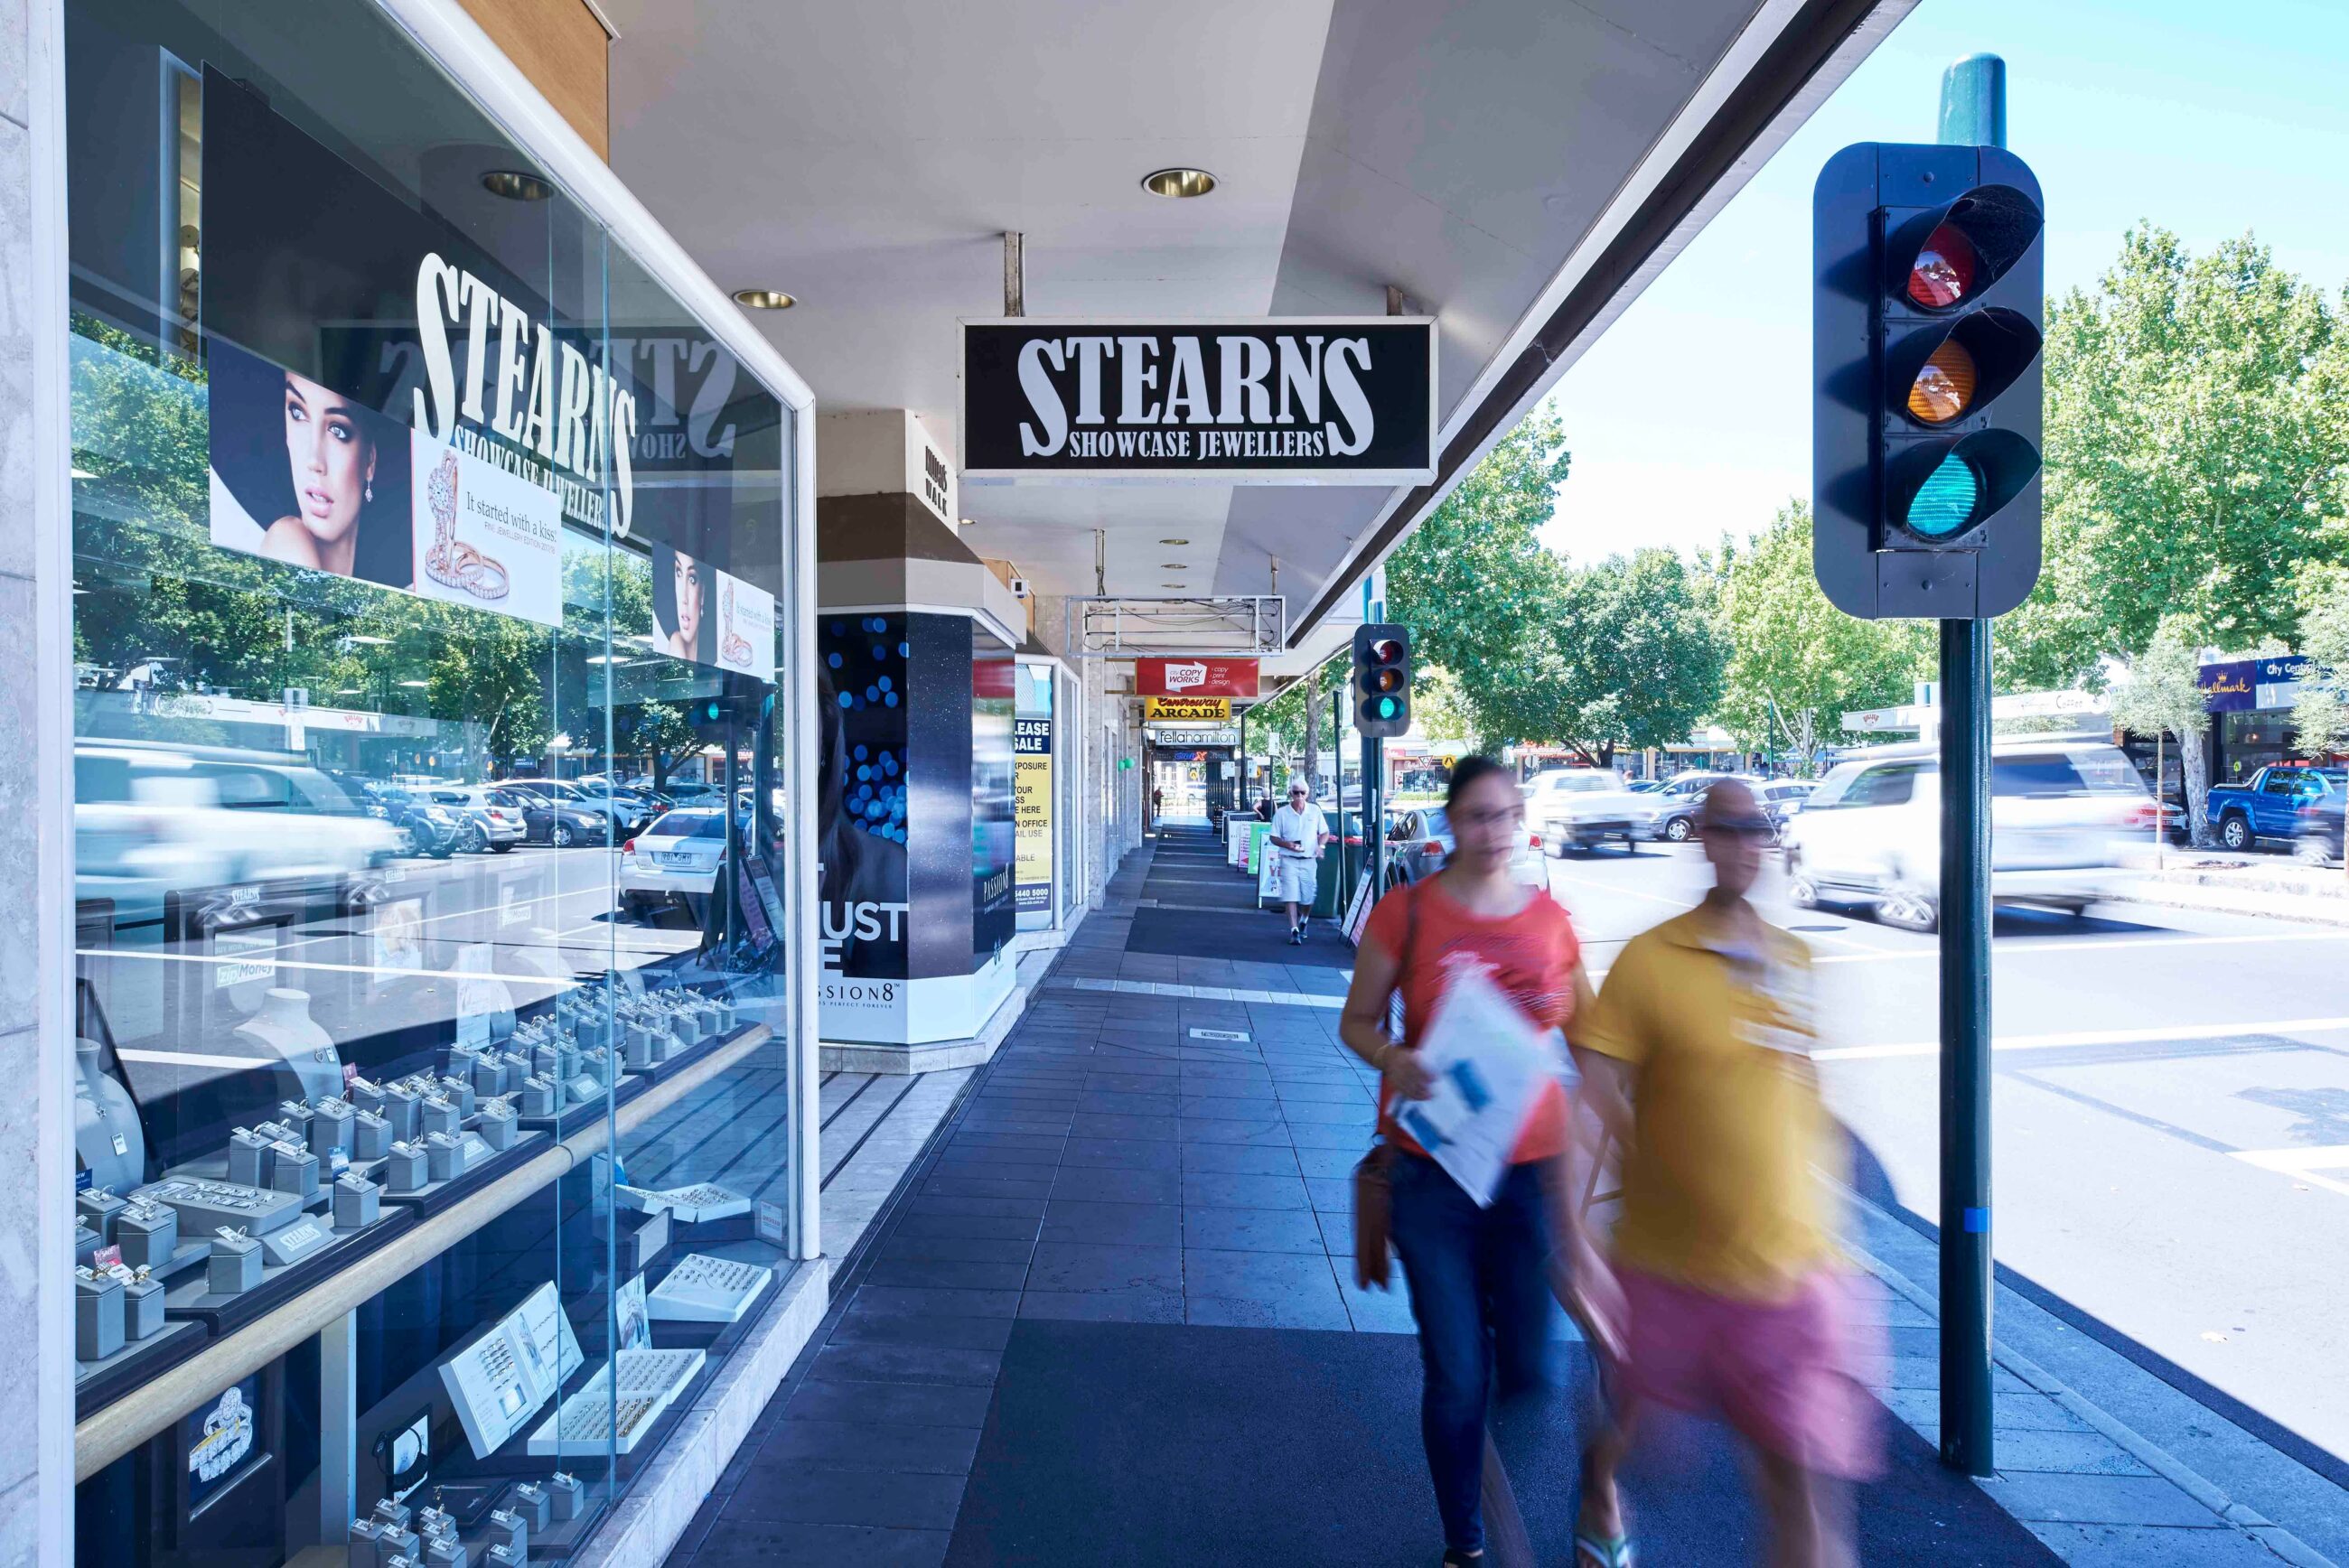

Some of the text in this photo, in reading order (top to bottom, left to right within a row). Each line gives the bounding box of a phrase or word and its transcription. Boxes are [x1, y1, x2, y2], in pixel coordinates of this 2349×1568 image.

[414, 252, 636, 539] STEARNS
[1017, 335, 1374, 457] STEARNS
[1070, 432, 1325, 461] SHOWCASE JEWELLERS
[467, 491, 475, 512] It
[477, 500, 509, 524] started
[511, 513, 530, 533] with
[533, 522, 538, 535] a
[524, 536, 541, 549] EDITION
[1180, 668, 1203, 677] COPY
[2267, 662, 2282, 677] City
[1169, 676, 1200, 684] WORKS
[2196, 676, 2251, 695] Hallmark
[1156, 697, 1222, 708] Centreway
[1150, 708, 1225, 718] ARCADE
[1015, 722, 1050, 736] EASE
[1160, 731, 1236, 742] fellahamilton
[1015, 786, 1033, 794] OUR
[1022, 806, 1041, 814] HERE
[1022, 819, 1048, 827] OFFICE
[1028, 829, 1043, 837] USE
[1016, 854, 1035, 862] ABLE
[983, 862, 1009, 902] PASSION8
[231, 887, 260, 904] STEARNS
[1032, 889, 1048, 897] 5000
[818, 901, 909, 942] UST
